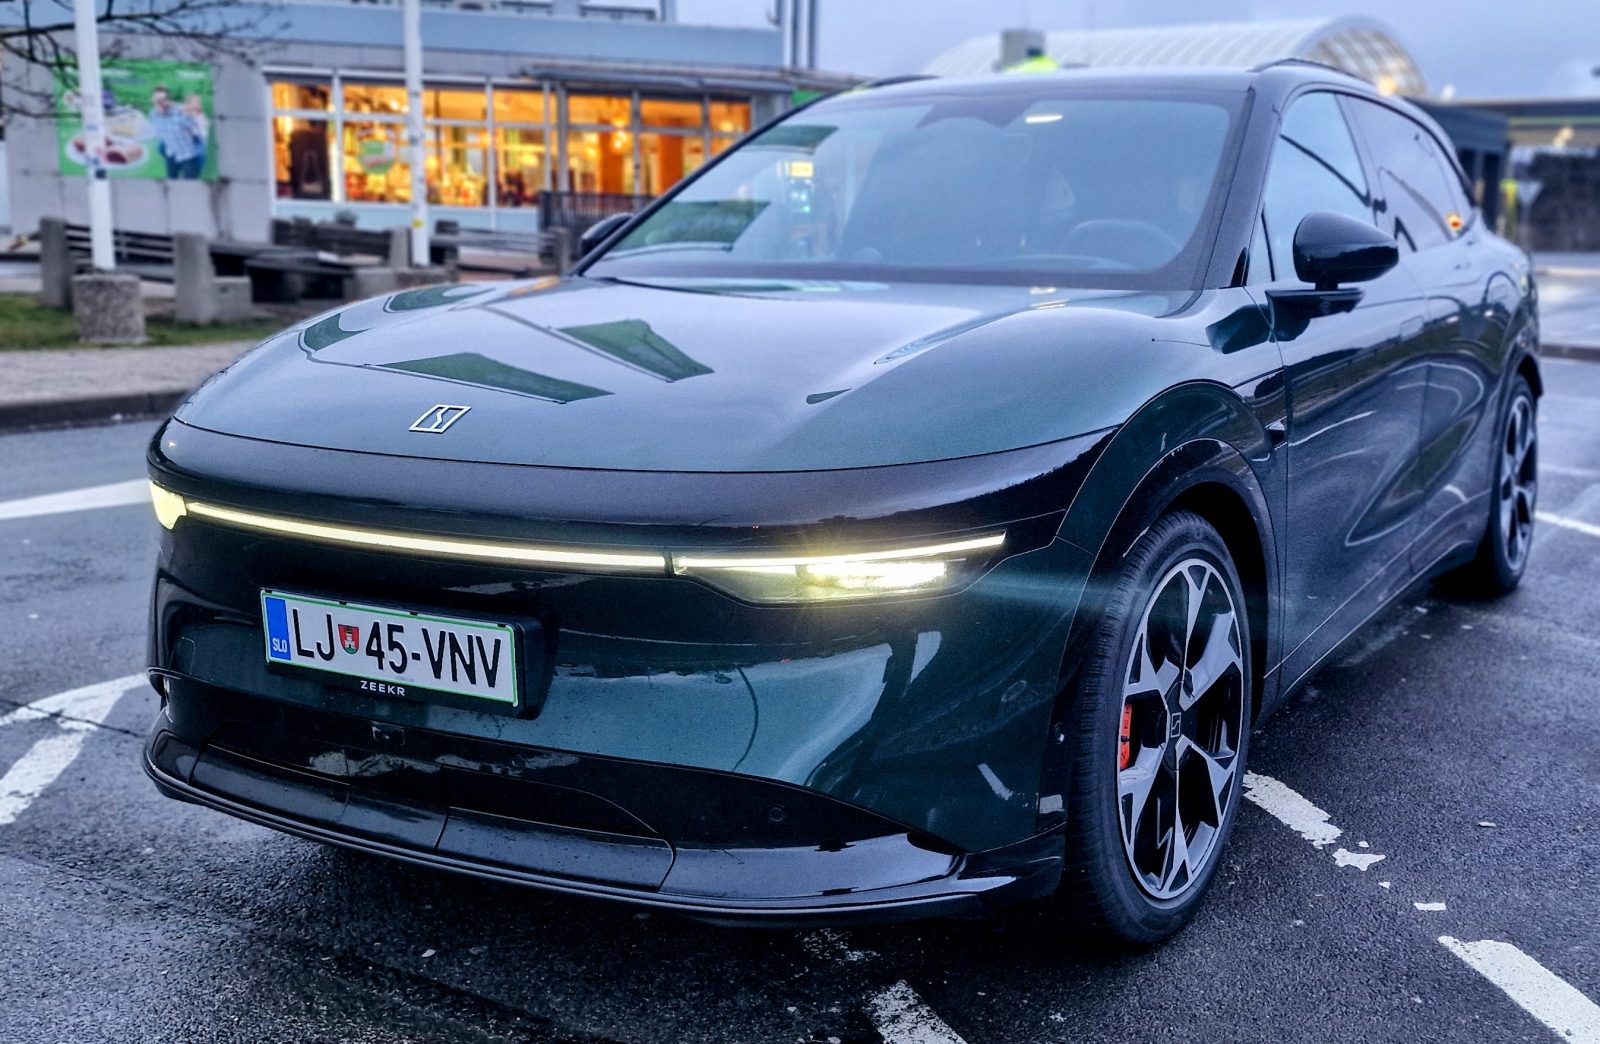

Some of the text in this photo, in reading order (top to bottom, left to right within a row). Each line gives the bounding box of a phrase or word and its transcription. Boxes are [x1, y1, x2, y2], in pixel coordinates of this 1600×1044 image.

[271, 638, 288, 653] SLO
[292, 608, 502, 688] LJ 45-VNV
[360, 680, 406, 696] ZEEKR
